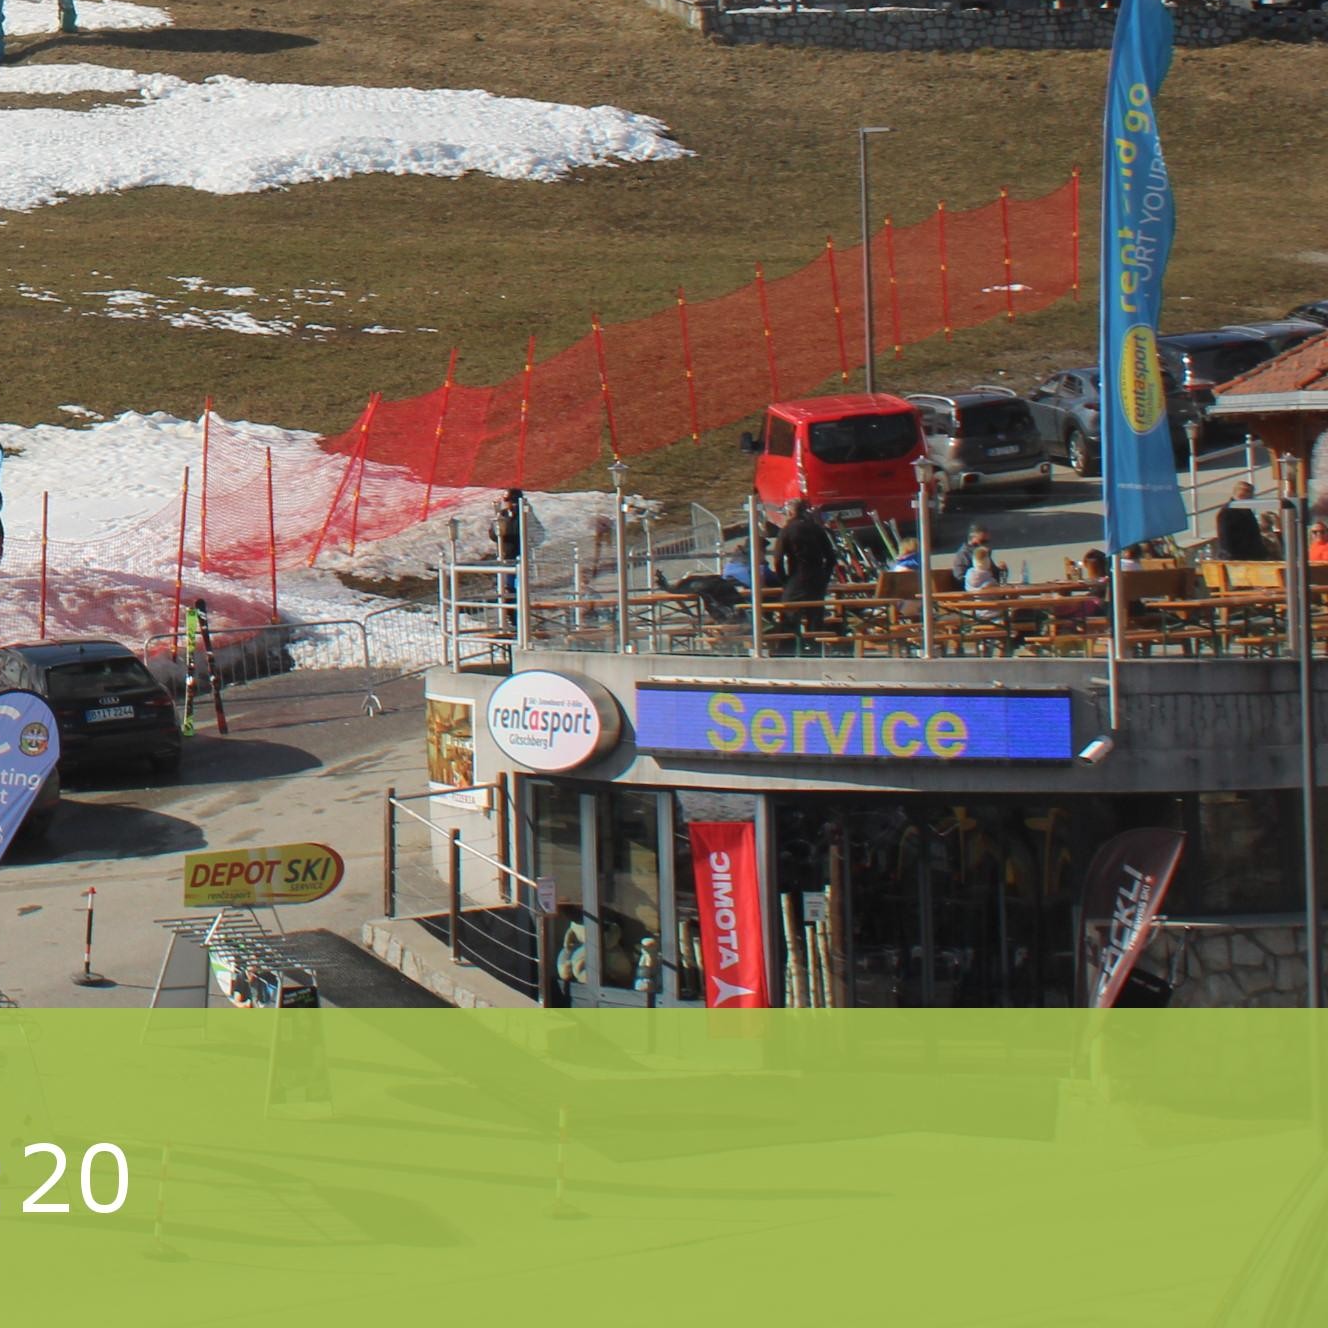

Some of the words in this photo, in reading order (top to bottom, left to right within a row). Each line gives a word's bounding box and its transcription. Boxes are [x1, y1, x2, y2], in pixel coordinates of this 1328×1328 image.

[1125, 82, 1150, 133] go
[1134, 335, 1150, 424] rentasport
[493, 697, 591, 747] rentasport
[707, 692, 968, 757] Service
[190, 860, 282, 888] DEPOT
[284, 857, 331, 884] SKI
